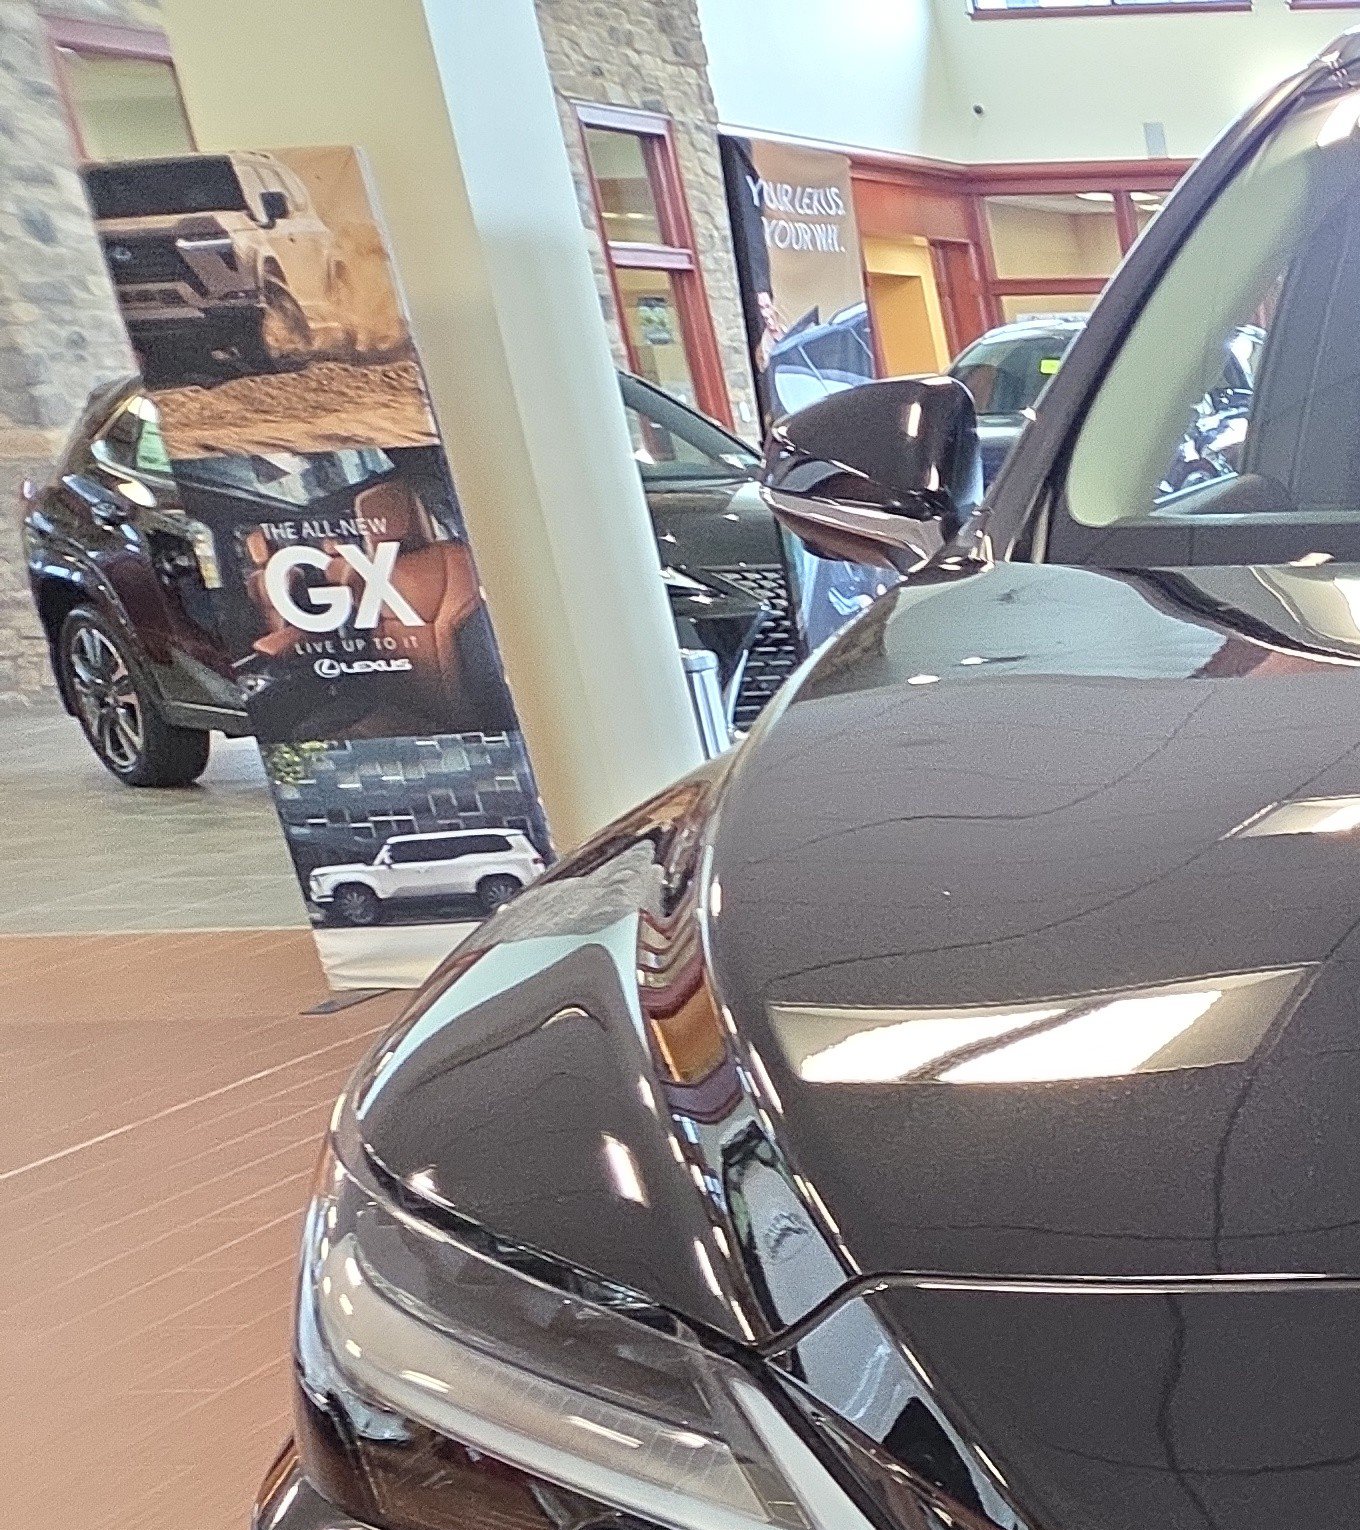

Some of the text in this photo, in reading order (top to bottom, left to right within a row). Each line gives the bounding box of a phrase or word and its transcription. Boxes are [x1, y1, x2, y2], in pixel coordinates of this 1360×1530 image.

[760, 216, 814, 252] YOUR
[259, 517, 387, 540] THE ALL-NEW
[265, 541, 427, 632] GX
[294, 636, 418, 655] LIVE UP TO IT
